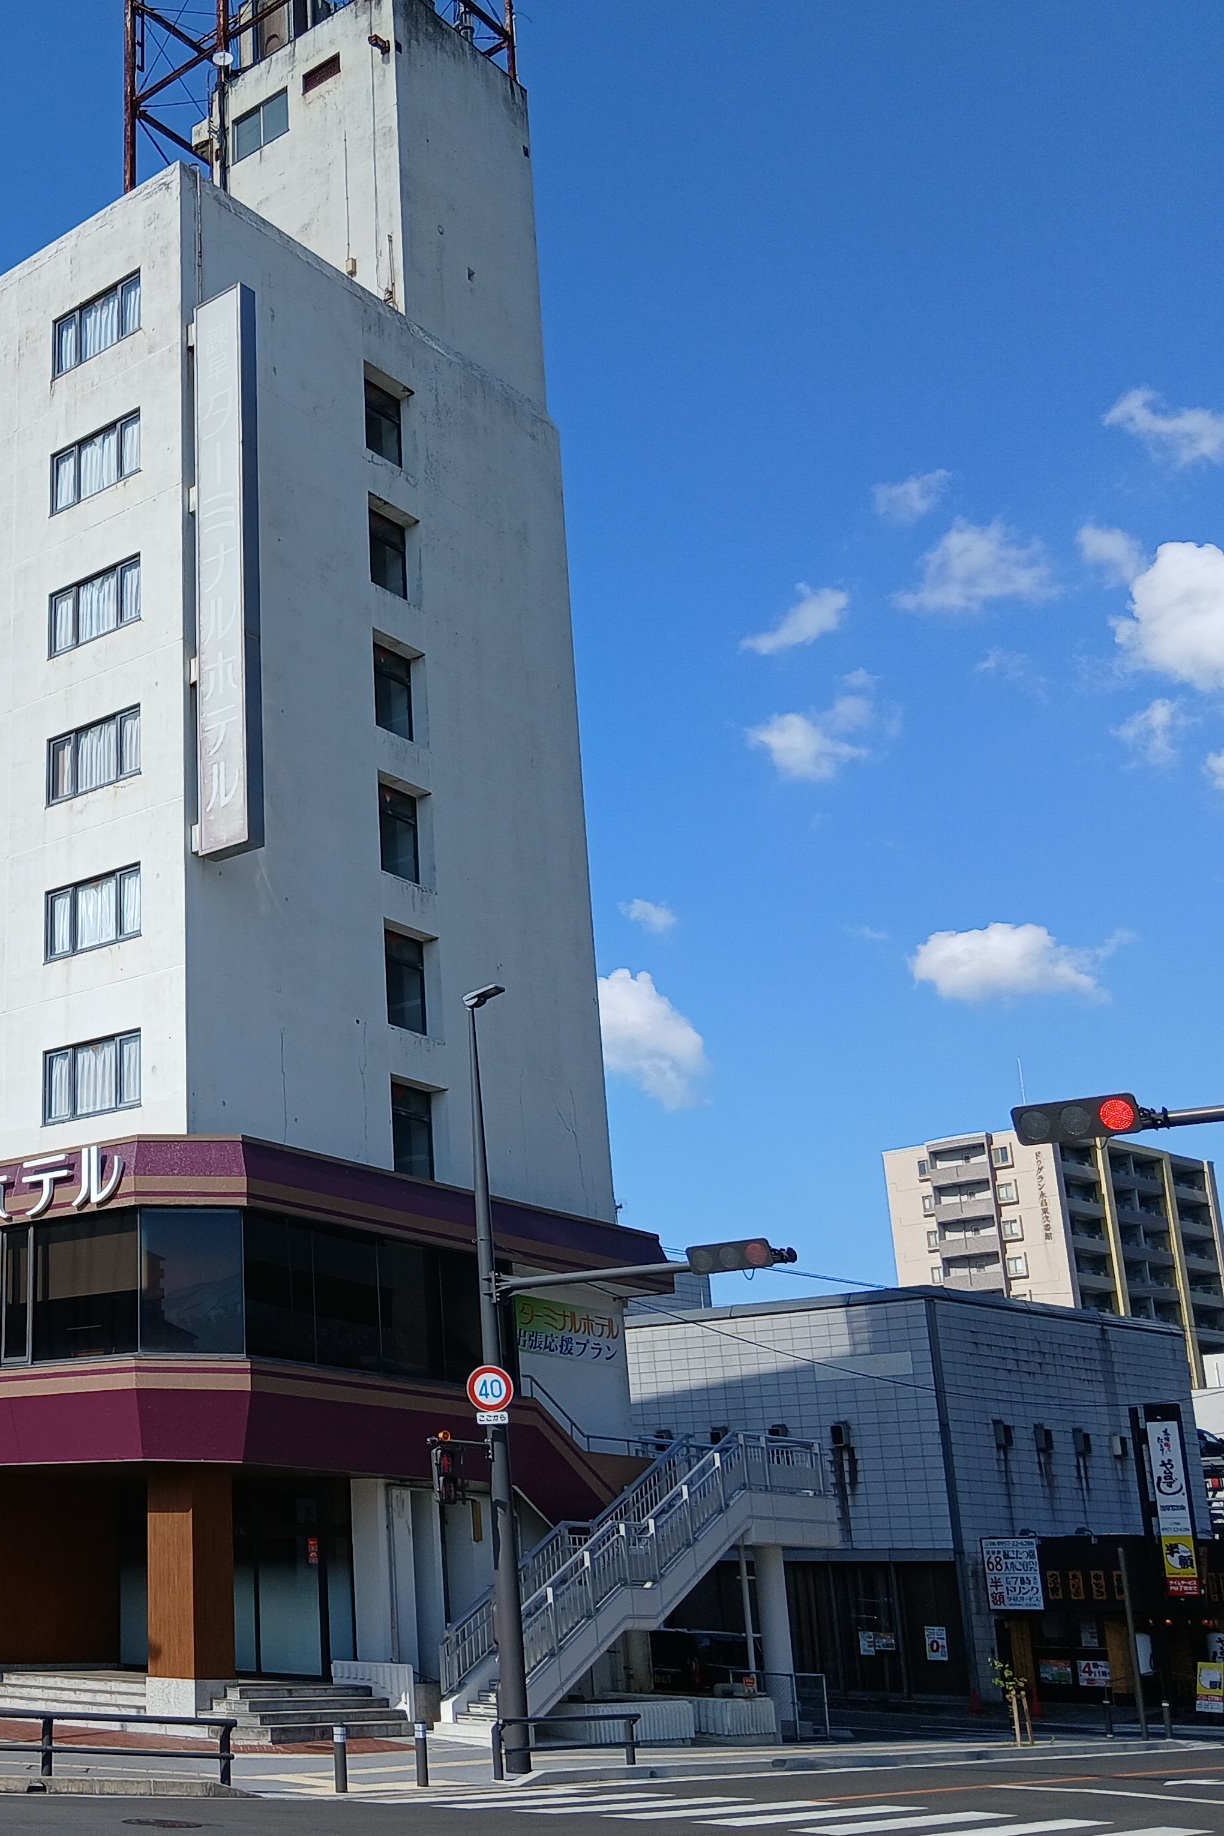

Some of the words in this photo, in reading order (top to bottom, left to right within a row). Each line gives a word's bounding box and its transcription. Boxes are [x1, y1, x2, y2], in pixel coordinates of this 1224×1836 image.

[203, 321, 240, 813] 諫早ターミナルホテル
[520, 1303, 619, 1340] ターミナルホテル
[518, 1328, 617, 1361] 出張応援プラン
[479, 1379, 502, 1399] 40
[479, 1414, 506, 1422] ここから
[987, 1555, 1003, 1572] 68
[990, 1576, 1006, 1606] 半額
[1006, 1586, 1040, 1595] ドリンク
